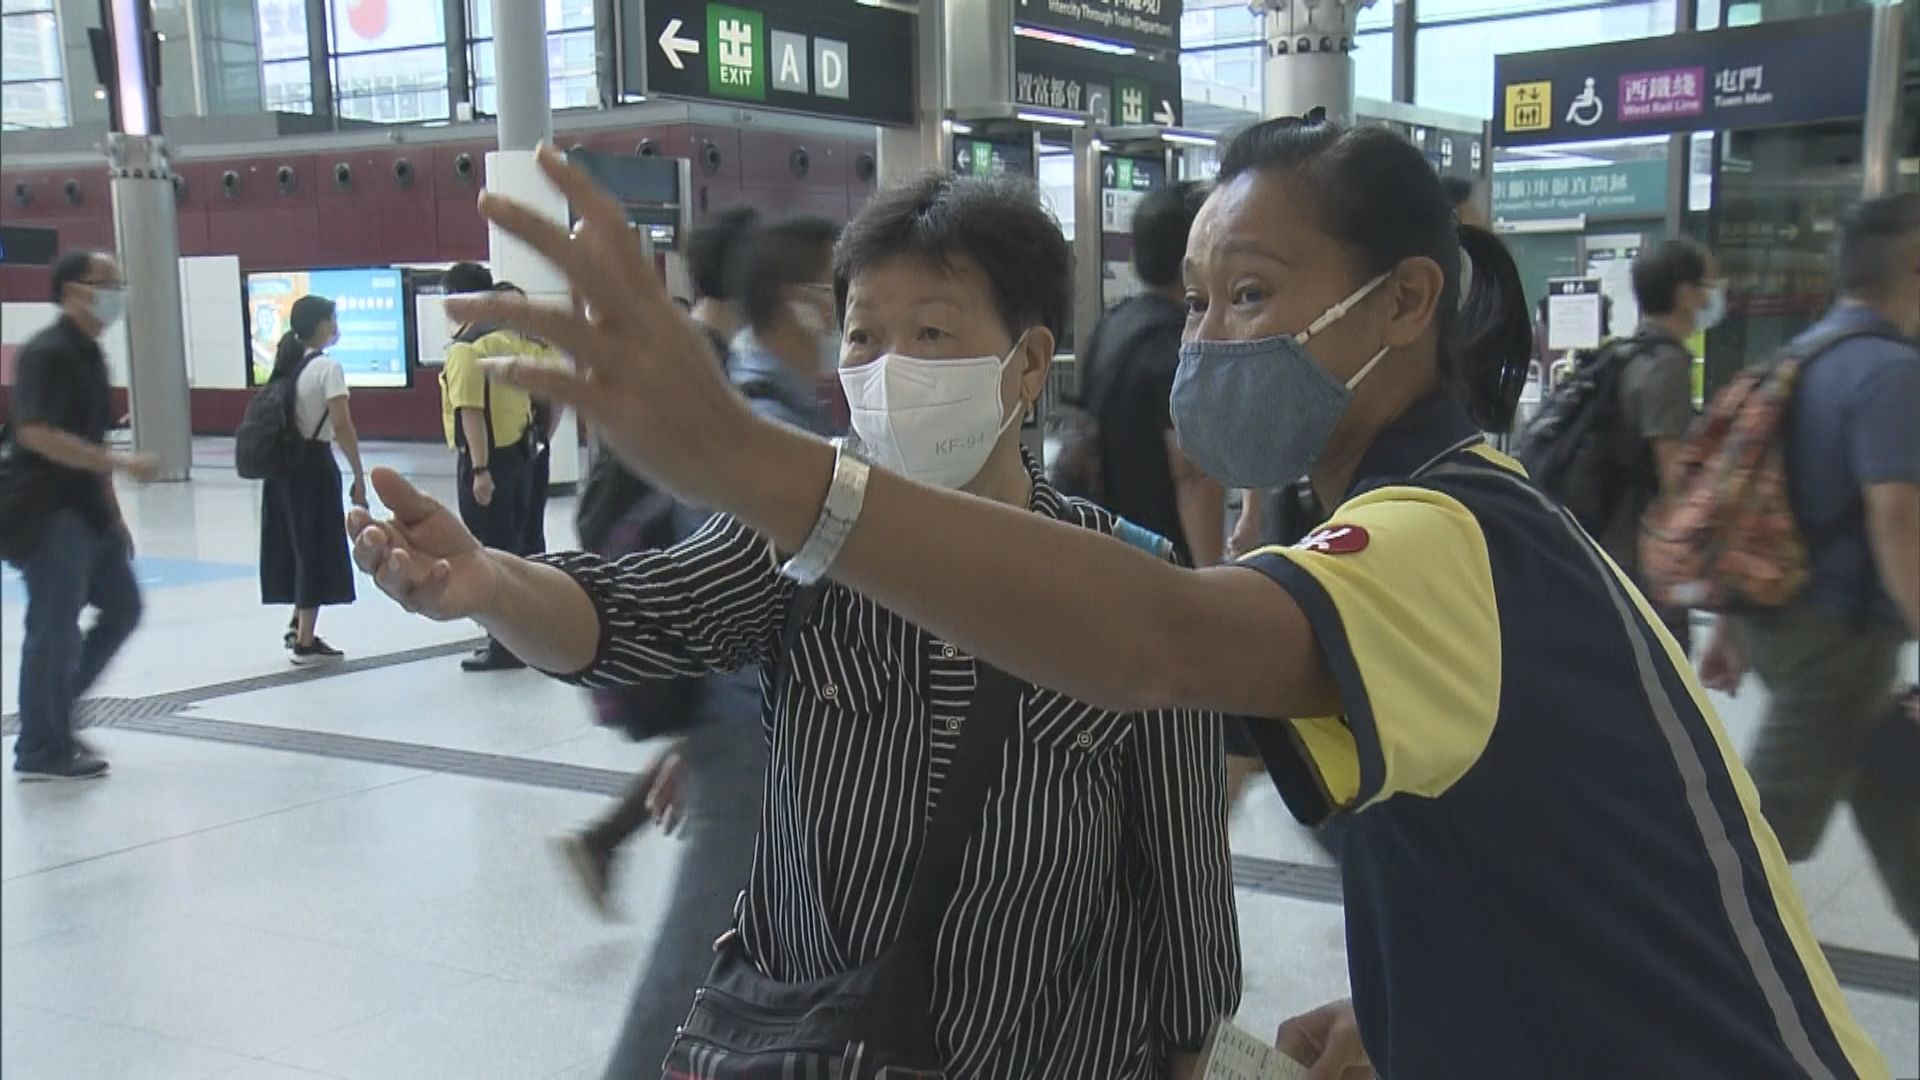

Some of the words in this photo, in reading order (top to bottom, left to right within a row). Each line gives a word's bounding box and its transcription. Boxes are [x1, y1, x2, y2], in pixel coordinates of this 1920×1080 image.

[720, 66, 752, 86] EXIT
[780, 43, 799, 84] A
[822, 50, 842, 89] D
[1715, 65, 1763, 93] 屯門
[1623, 104, 1650, 117] West
[1652, 101, 1674, 114] Rail
[1675, 99, 1700, 112] Line
[1715, 95, 1743, 107] Tuen
[1745, 92, 1773, 104] Mun
[936, 432, 984, 455] KF-94
